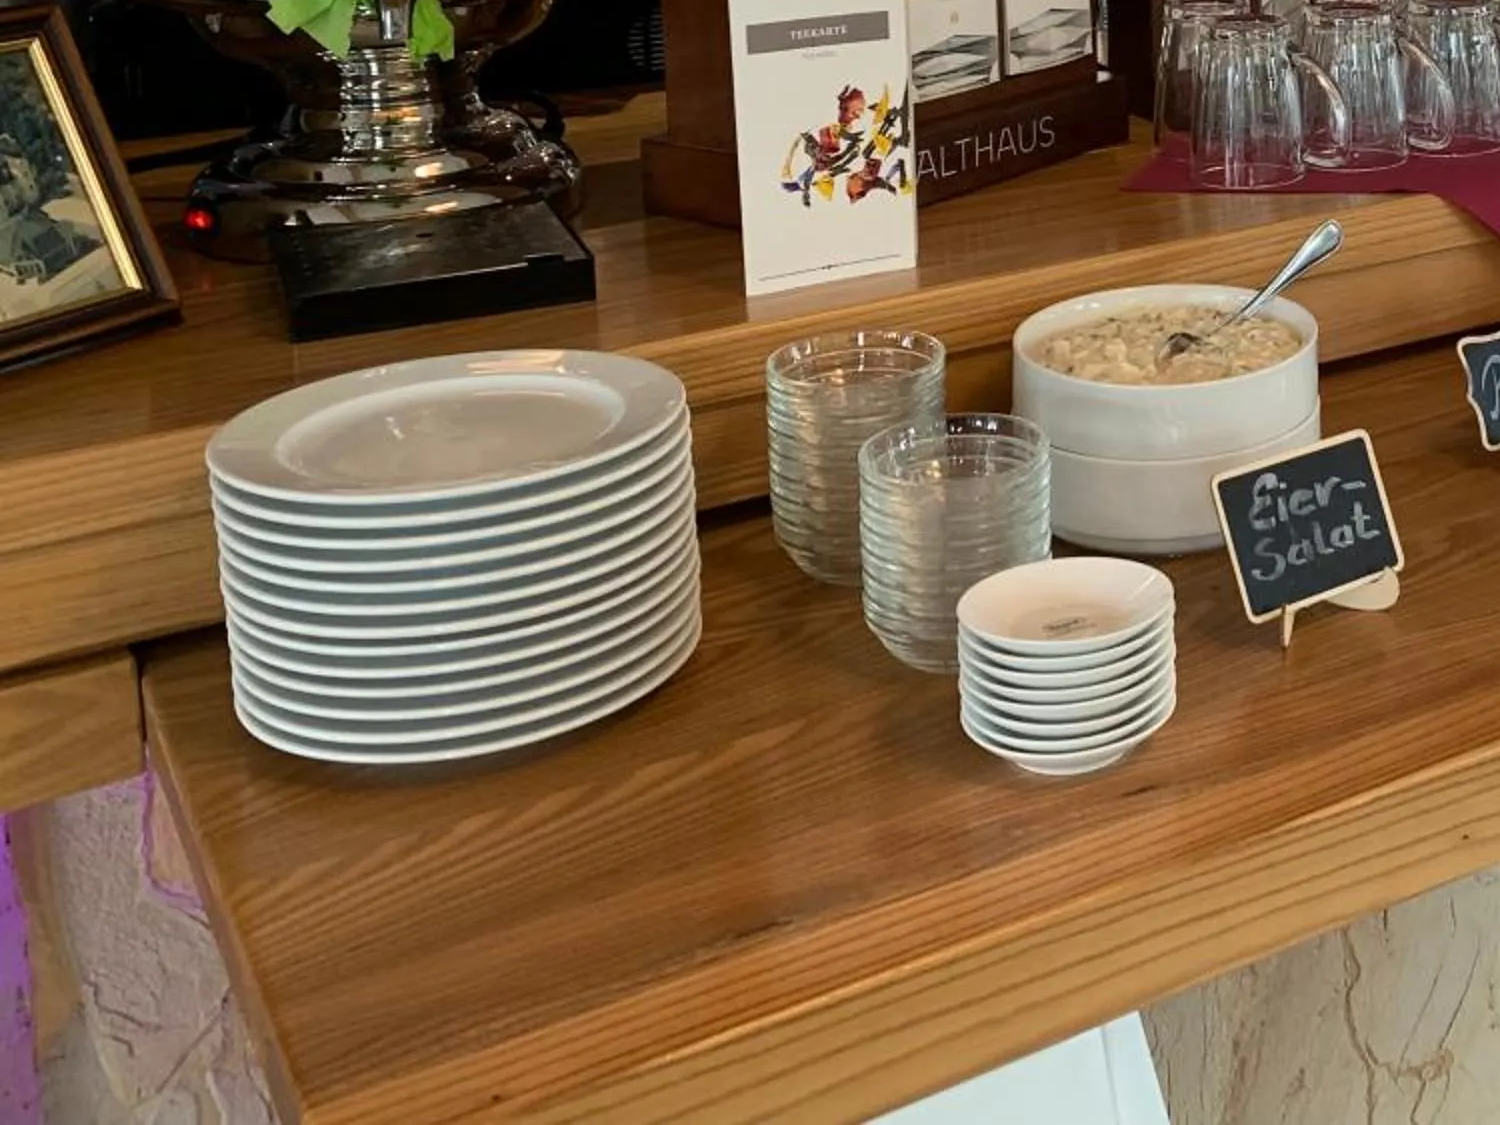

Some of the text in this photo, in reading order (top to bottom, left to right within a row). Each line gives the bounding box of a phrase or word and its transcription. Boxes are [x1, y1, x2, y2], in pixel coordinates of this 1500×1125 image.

[789, 25, 848, 41] TEEKARTE
[917, 115, 1056, 180] ALTHAUS
[1250, 472, 1367, 531] Eier-
[1251, 500, 1381, 581] Salat
